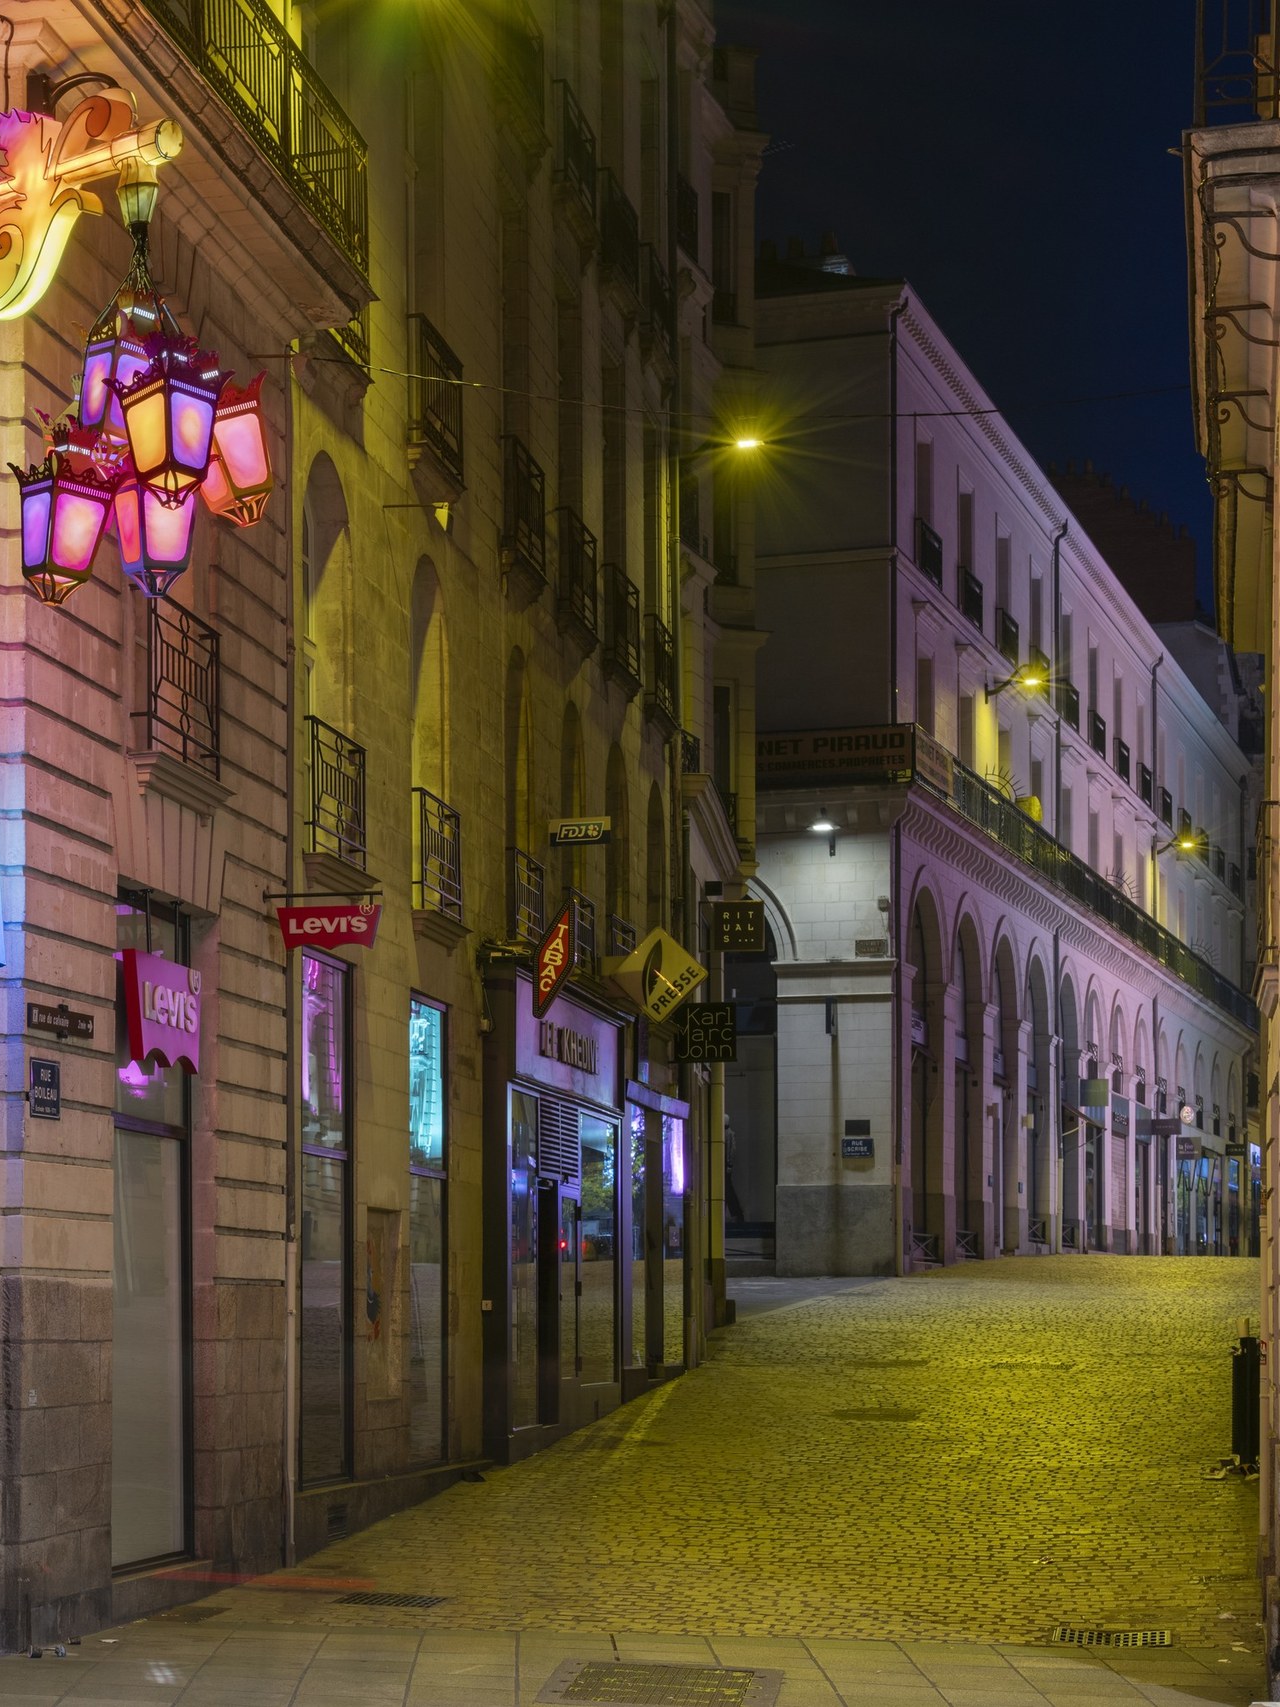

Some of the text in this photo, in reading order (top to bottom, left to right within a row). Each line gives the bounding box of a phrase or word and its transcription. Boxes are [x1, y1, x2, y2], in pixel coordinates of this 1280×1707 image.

[813, 733, 905, 753] PIRAUD
[561, 826, 587, 838] FDJ
[539, 923, 568, 992] TABAC
[650, 966, 699, 1015] PRESSE
[47, 1012, 52, 1024] du
[687, 1007, 733, 1025] Karl
[678, 1039, 732, 1059] John
[40, 1069, 51, 1082] RUE
[34, 1086, 57, 1101] BOILEAU
